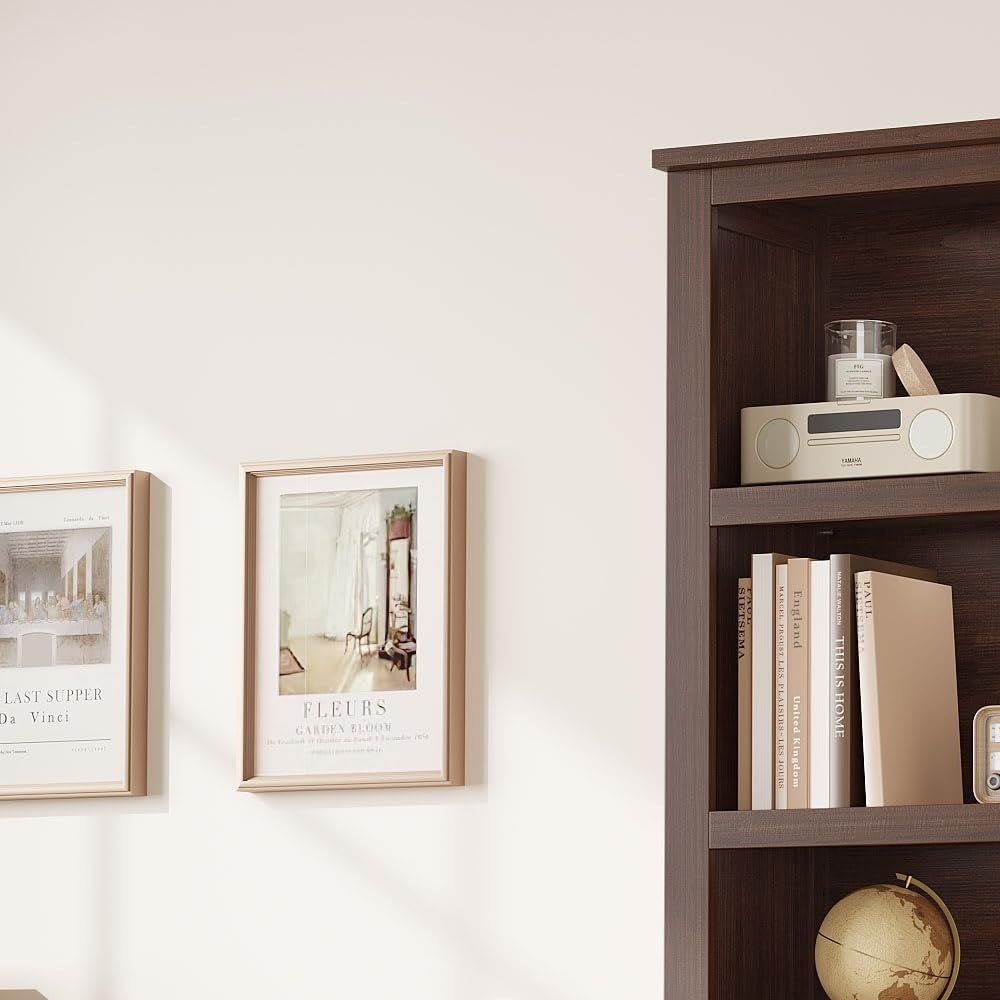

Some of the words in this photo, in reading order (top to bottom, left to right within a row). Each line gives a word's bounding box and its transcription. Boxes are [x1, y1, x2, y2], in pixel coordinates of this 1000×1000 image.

[864, 580, 872, 619] PAUL
[792, 590, 802, 649] England
[835, 636, 845, 670] THIS
[835, 675, 845, 688] IS
[4, 690, 42, 704] LAST
[46, 688, 102, 702] SUPPER
[304, 699, 386, 718] FLEURS
[0, 712, 16, 724] Da
[30, 710, 70, 723] Vinci
[835, 692, 845, 738] HOME
[295, 724, 345, 736] GARDEN
[351, 722, 392, 733] BLOOM
[792, 738, 800, 788] Kingdom
